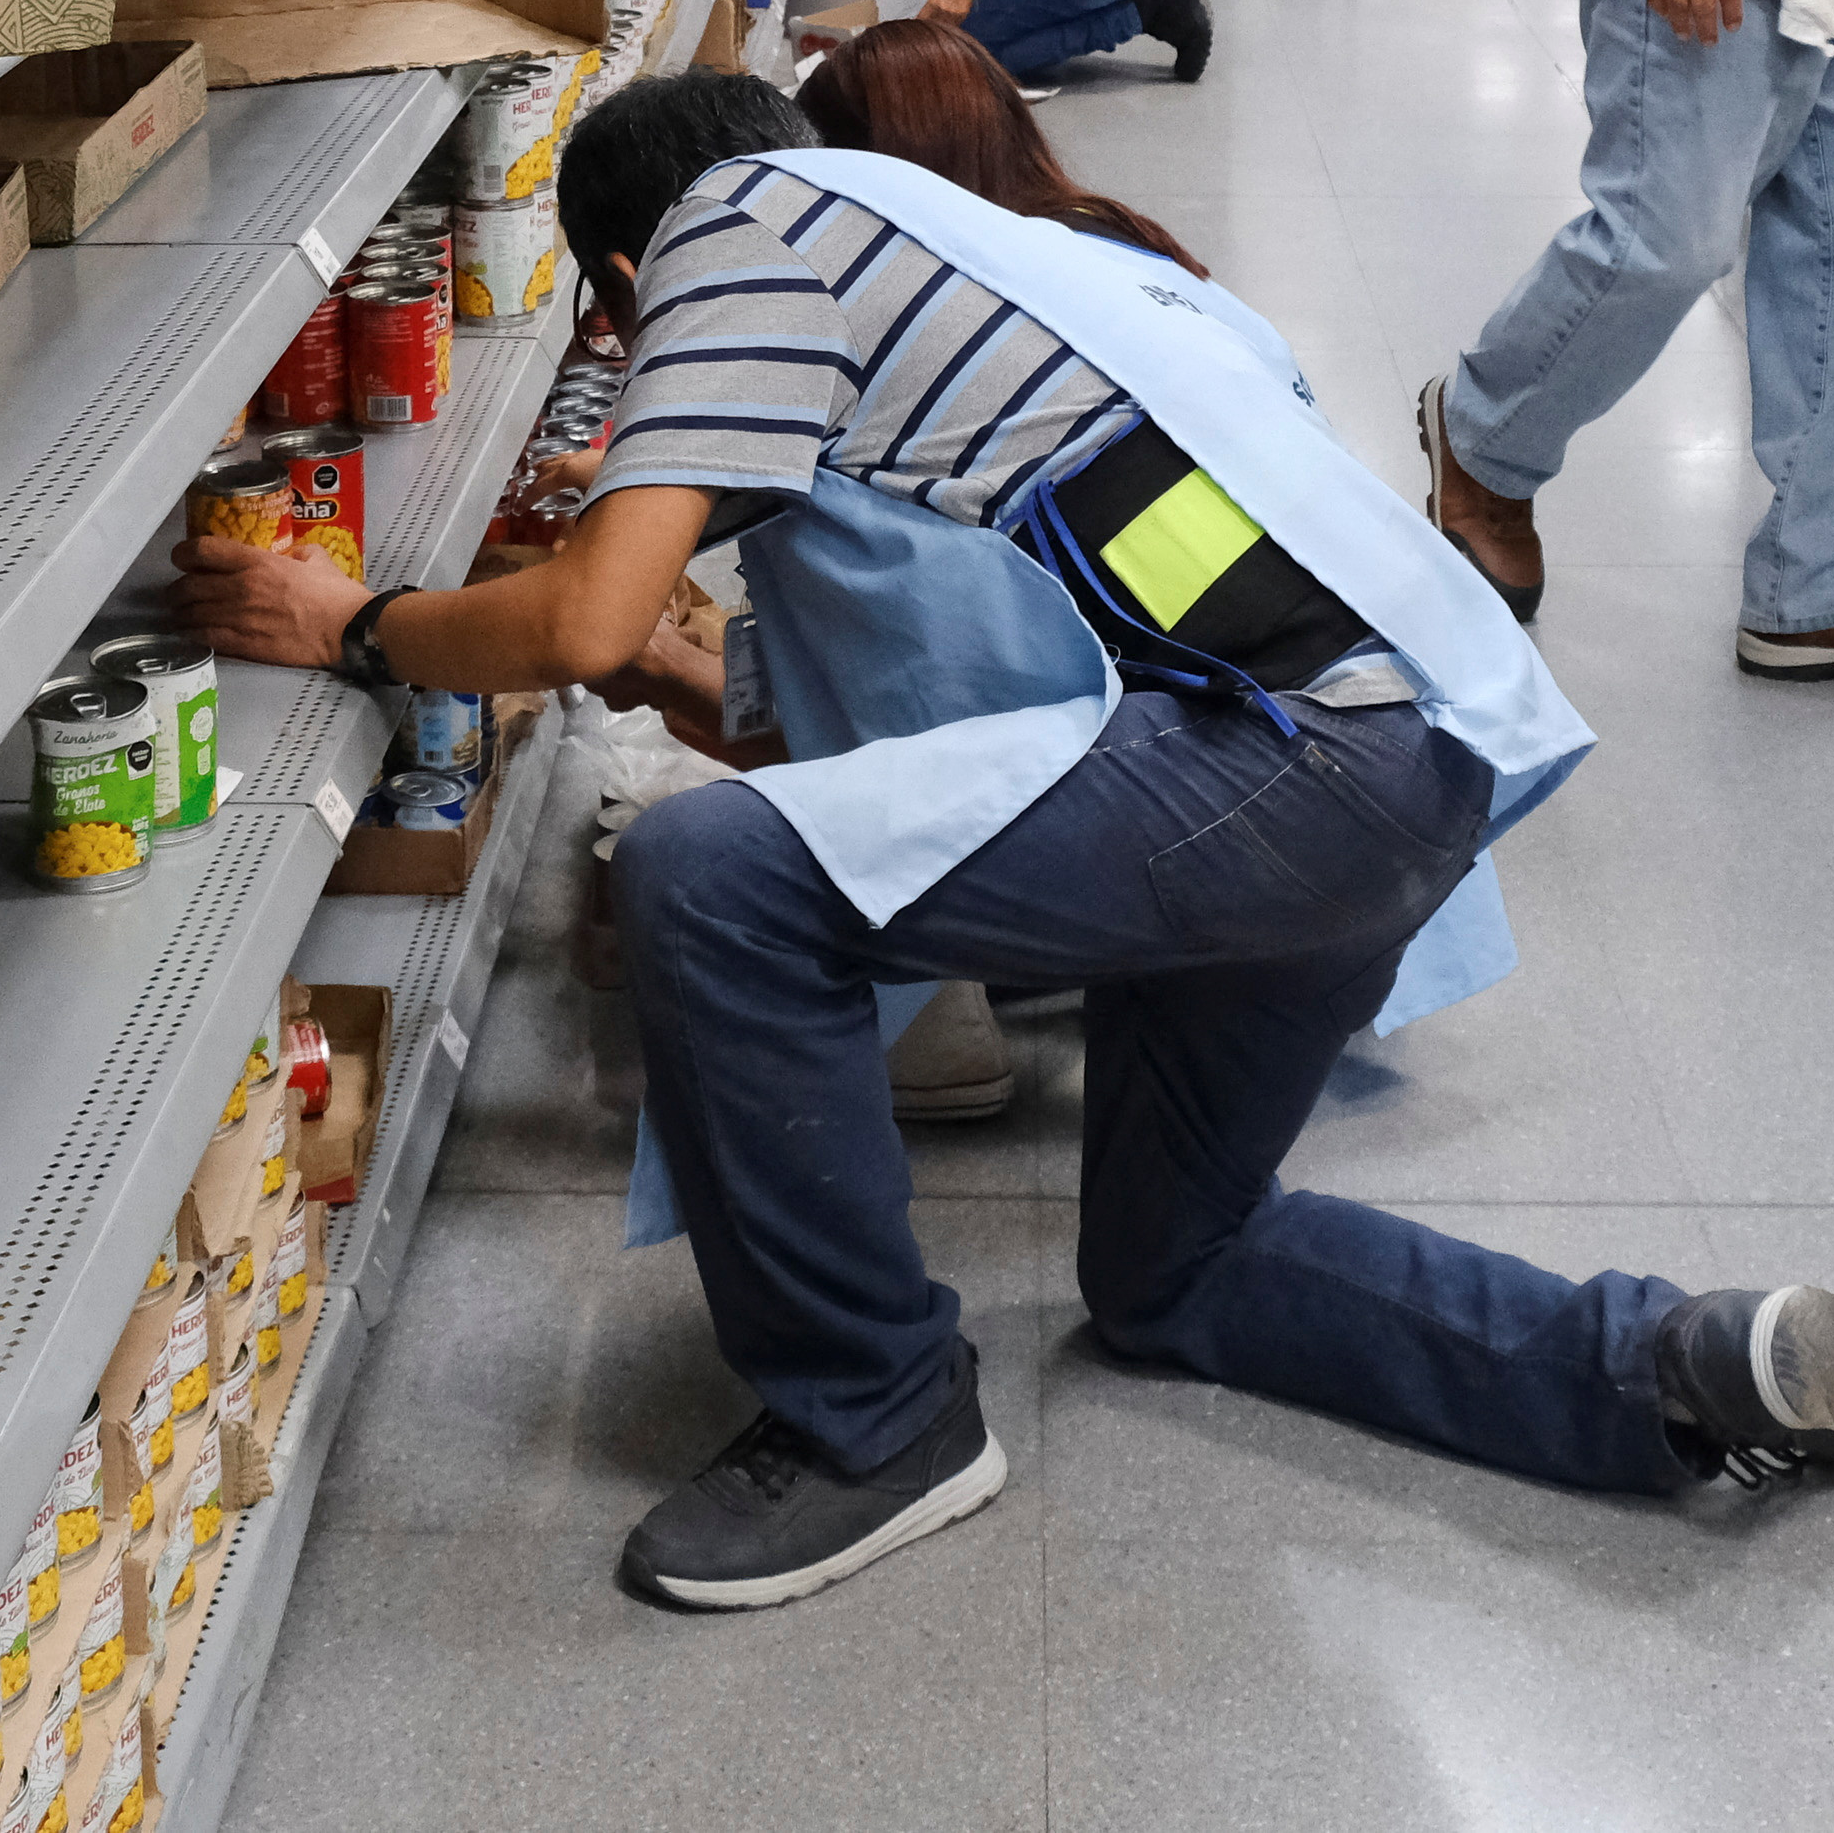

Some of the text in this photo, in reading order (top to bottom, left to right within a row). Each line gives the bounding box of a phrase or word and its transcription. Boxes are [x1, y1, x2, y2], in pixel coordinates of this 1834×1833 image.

[56, 784, 101, 801] Granos
[53, 798, 106, 817] de Elote
[171, 1311, 205, 1339] HERD
[145, 1364, 168, 1391] HER
[226, 1382, 250, 1408] HER
[60, 1439, 96, 1471] DEZ
